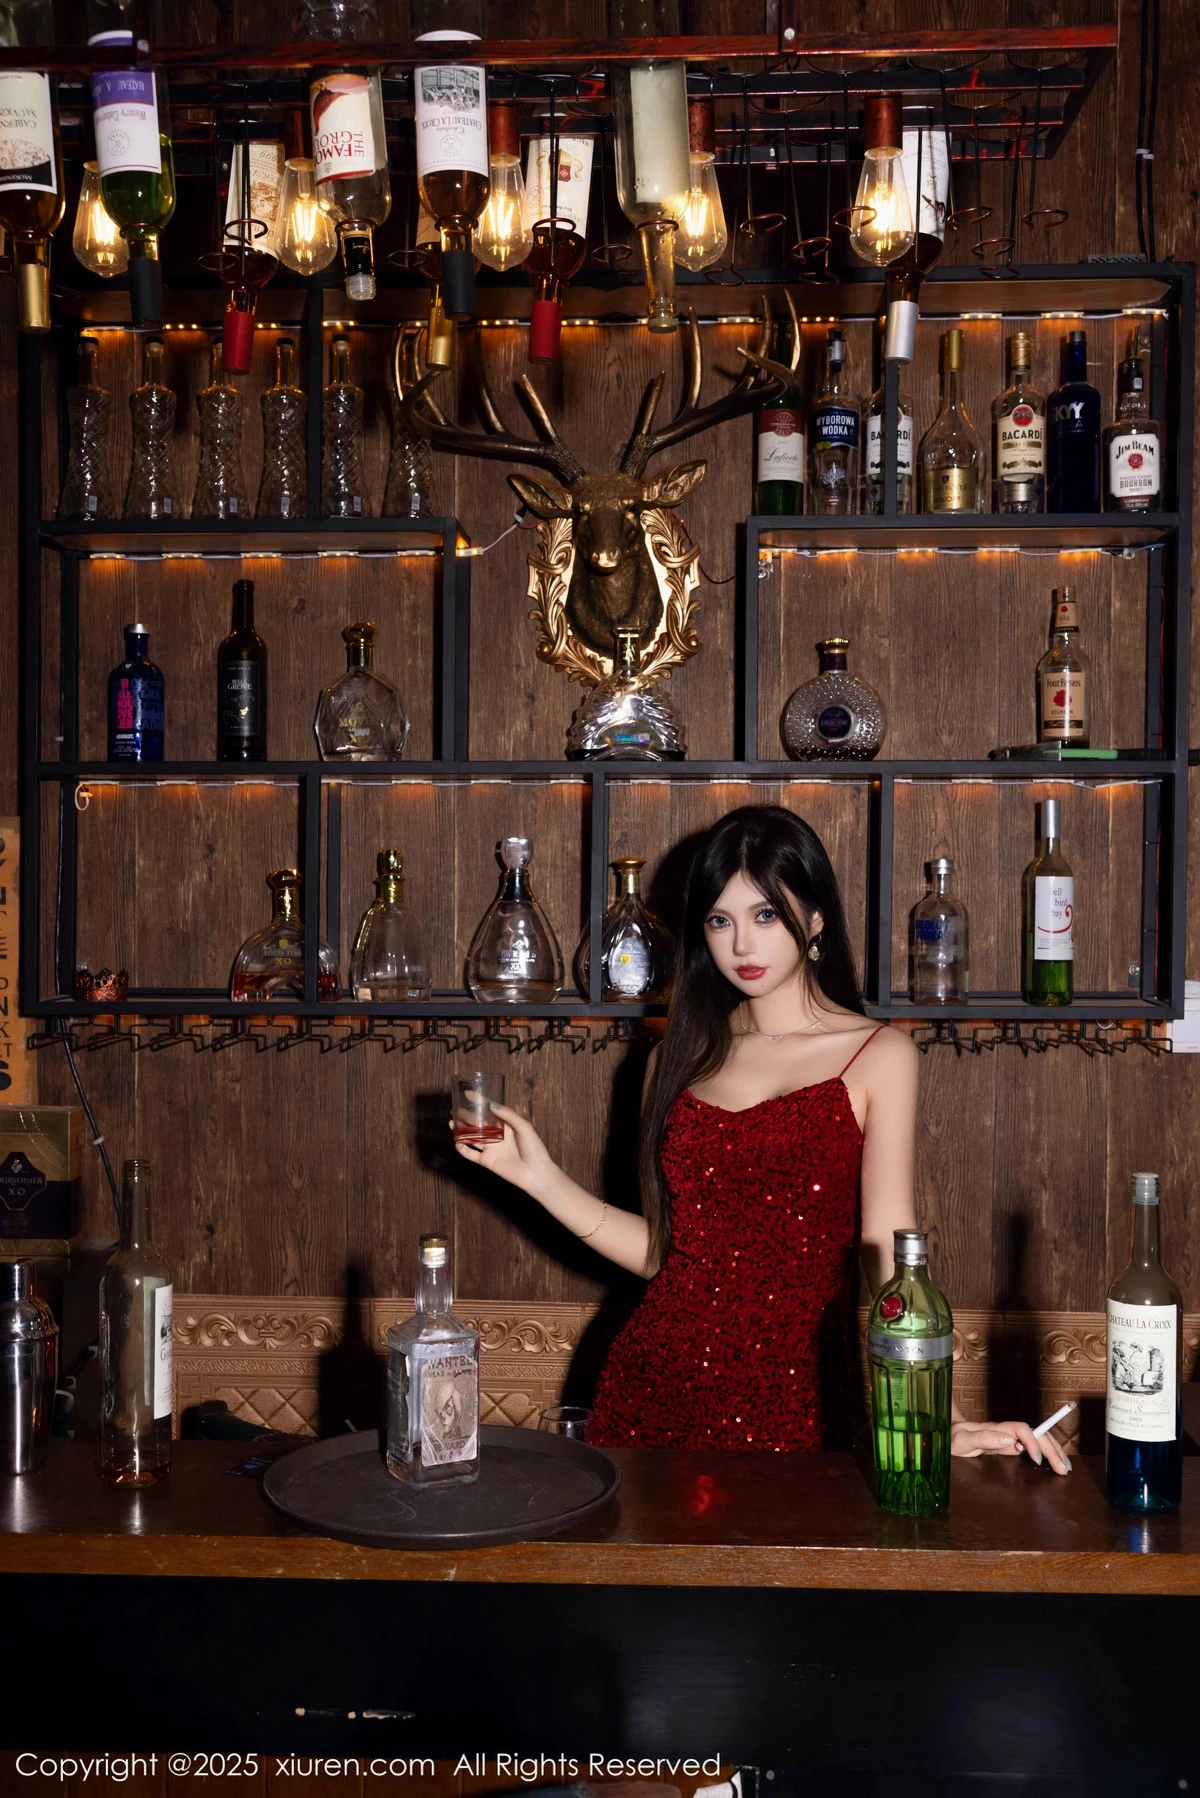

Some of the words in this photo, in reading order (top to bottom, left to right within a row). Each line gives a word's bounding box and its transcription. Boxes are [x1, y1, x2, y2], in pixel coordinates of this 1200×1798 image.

[121, 107, 148, 121] Winery
[421, 116, 441, 131] CROIX
[441, 116, 451, 128] LA
[452, 116, 483, 131] CHATEAU
[352, 131, 365, 158] THE
[1052, 402, 1085, 422] KYY
[816, 414, 855, 427] WYBOROWA
[821, 425, 848, 435] WODKA
[870, 428, 911, 441] BARDÍ
[1002, 428, 1043, 441] BACARDÍ
[1115, 442, 1131, 460] JIM
[1132, 440, 1155, 456] BEAM
[1119, 478, 1153, 489] BOURBON
[1060, 677, 1081, 688] Rses
[1054, 898, 1068, 906] bird
[275, 957, 292, 966] XO
[8, 1187, 26, 1196] XO
[1108, 1310, 1134, 1328] CHATEAU
[1136, 1317, 1147, 1329] LA
[1148, 1319, 1172, 1329] CROIX
